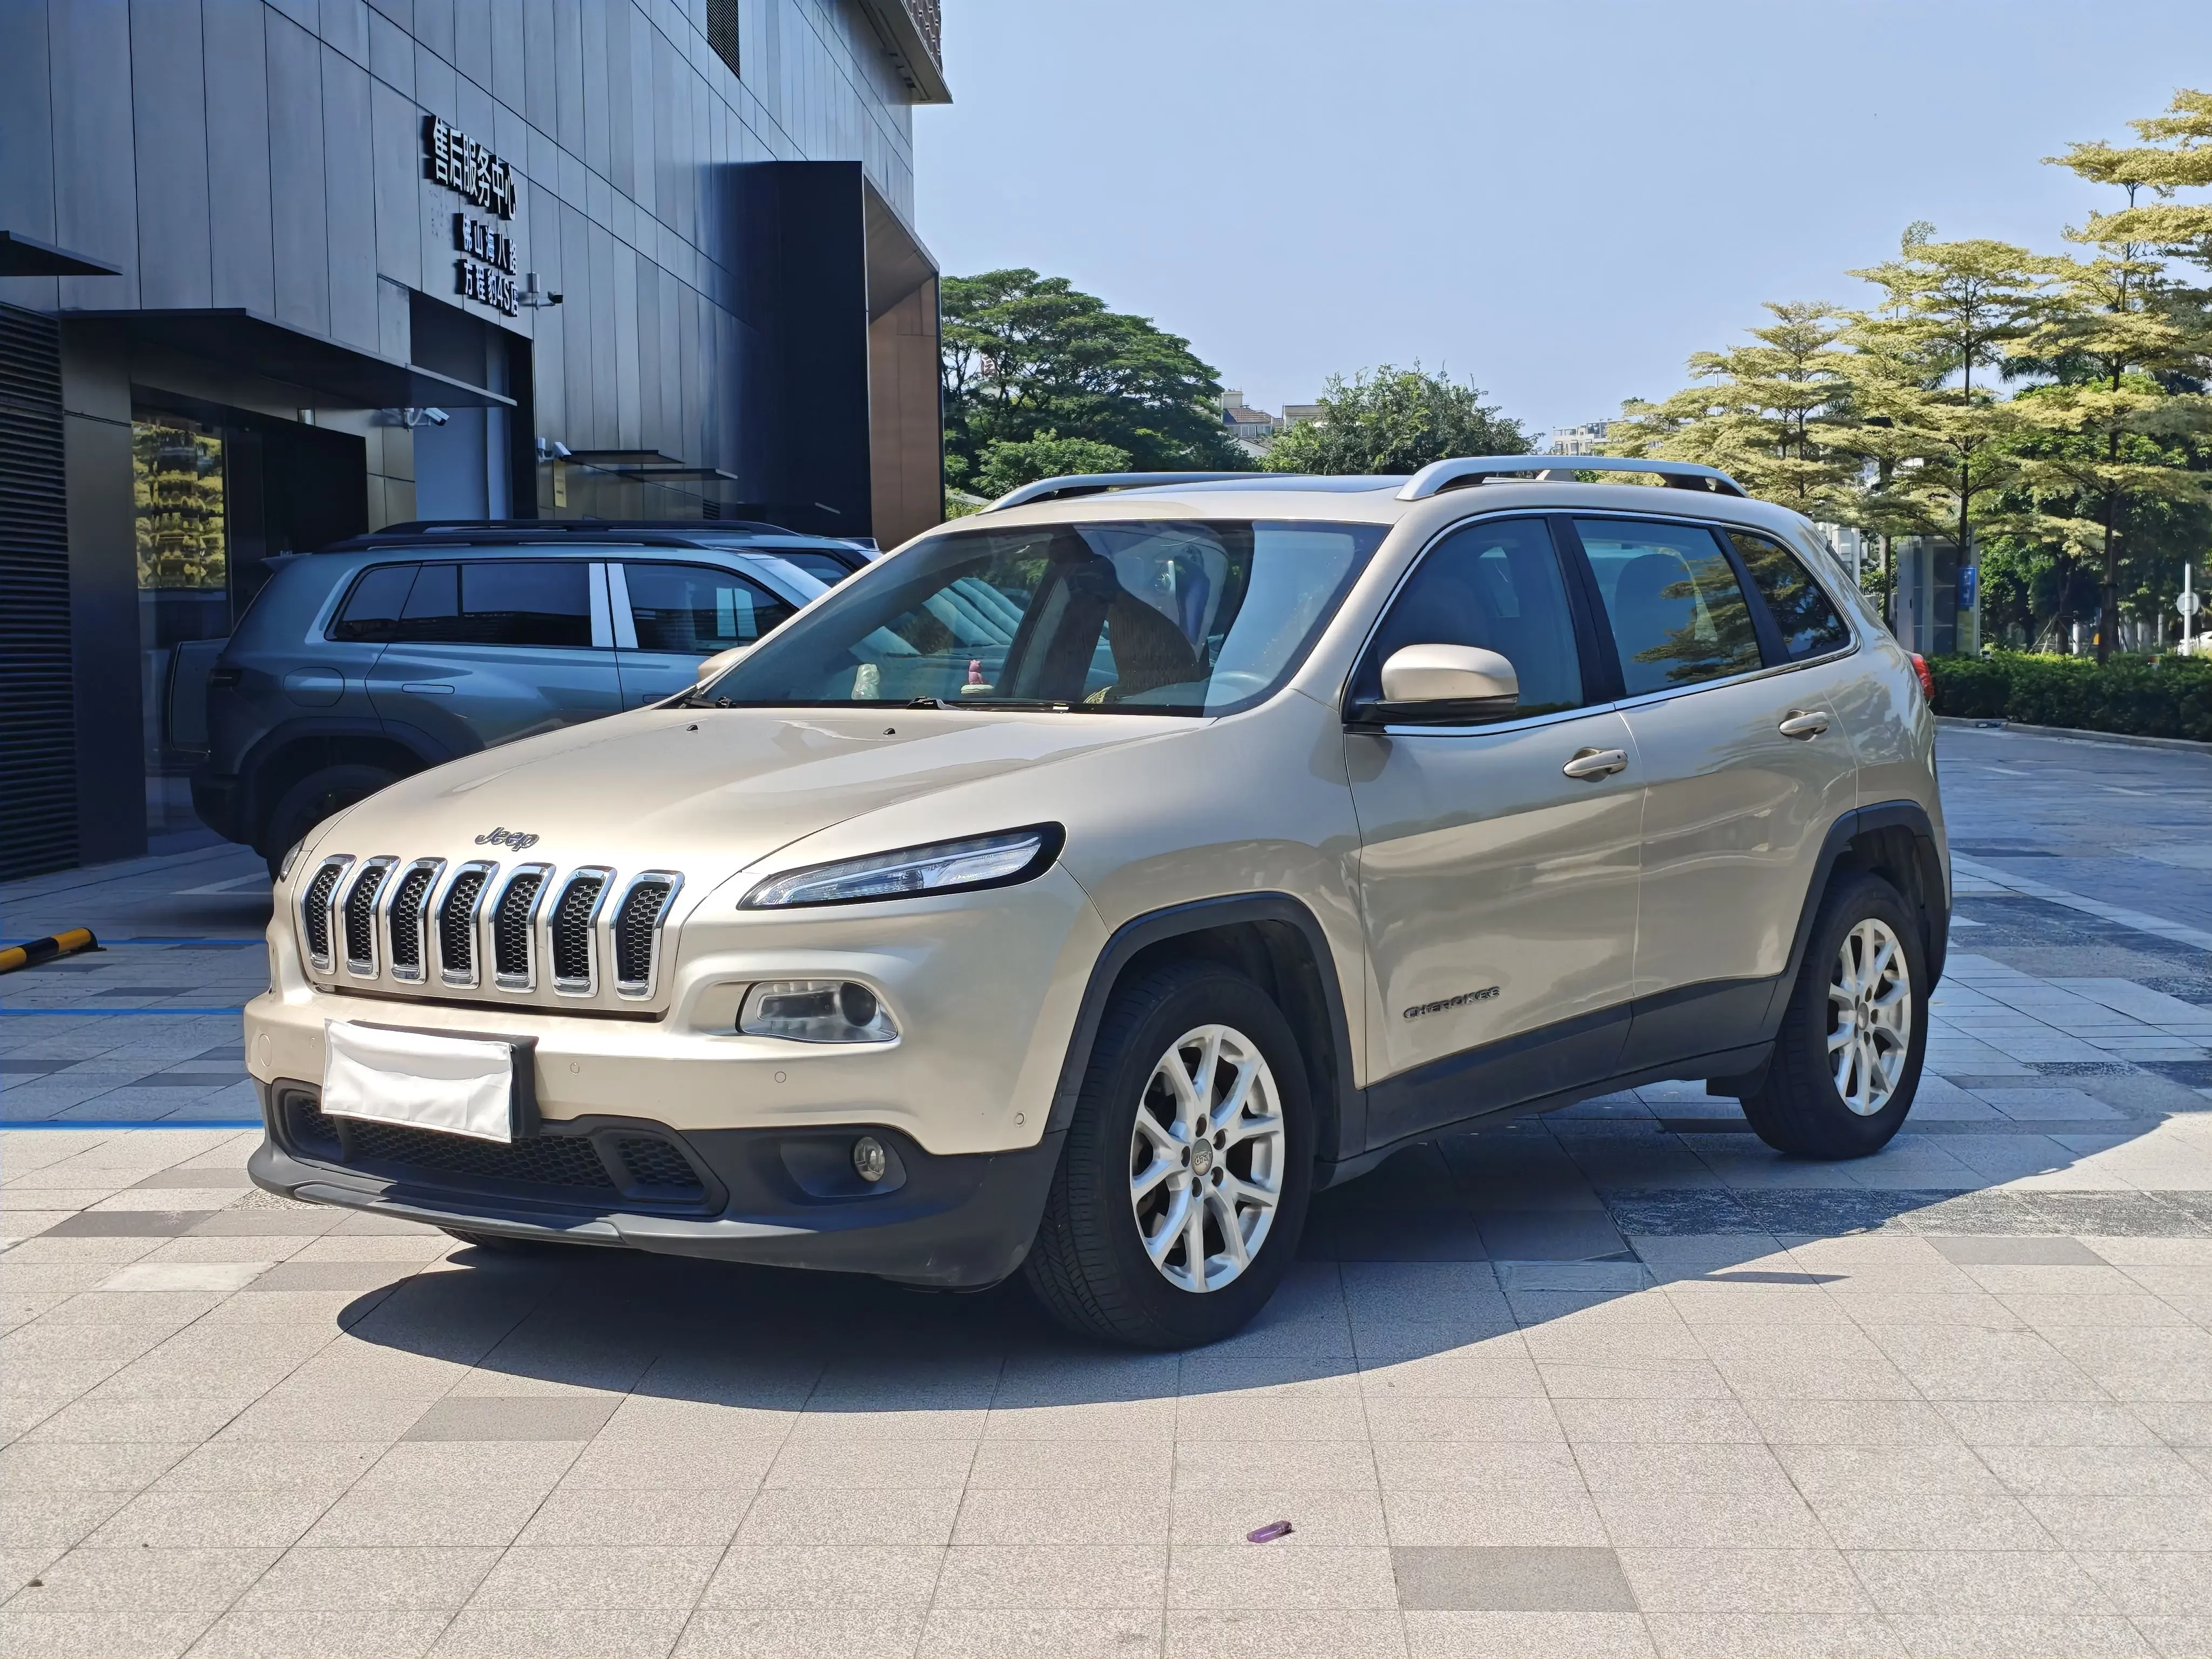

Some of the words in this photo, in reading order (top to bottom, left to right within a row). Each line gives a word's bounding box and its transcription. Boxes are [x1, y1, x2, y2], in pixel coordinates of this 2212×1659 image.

[433, 116, 517, 221] 售后服务中心
[464, 259, 518, 317] 方程豹4S店
[474, 827, 540, 852] Jeep
[1404, 986, 1500, 1019] CHEROKEE
